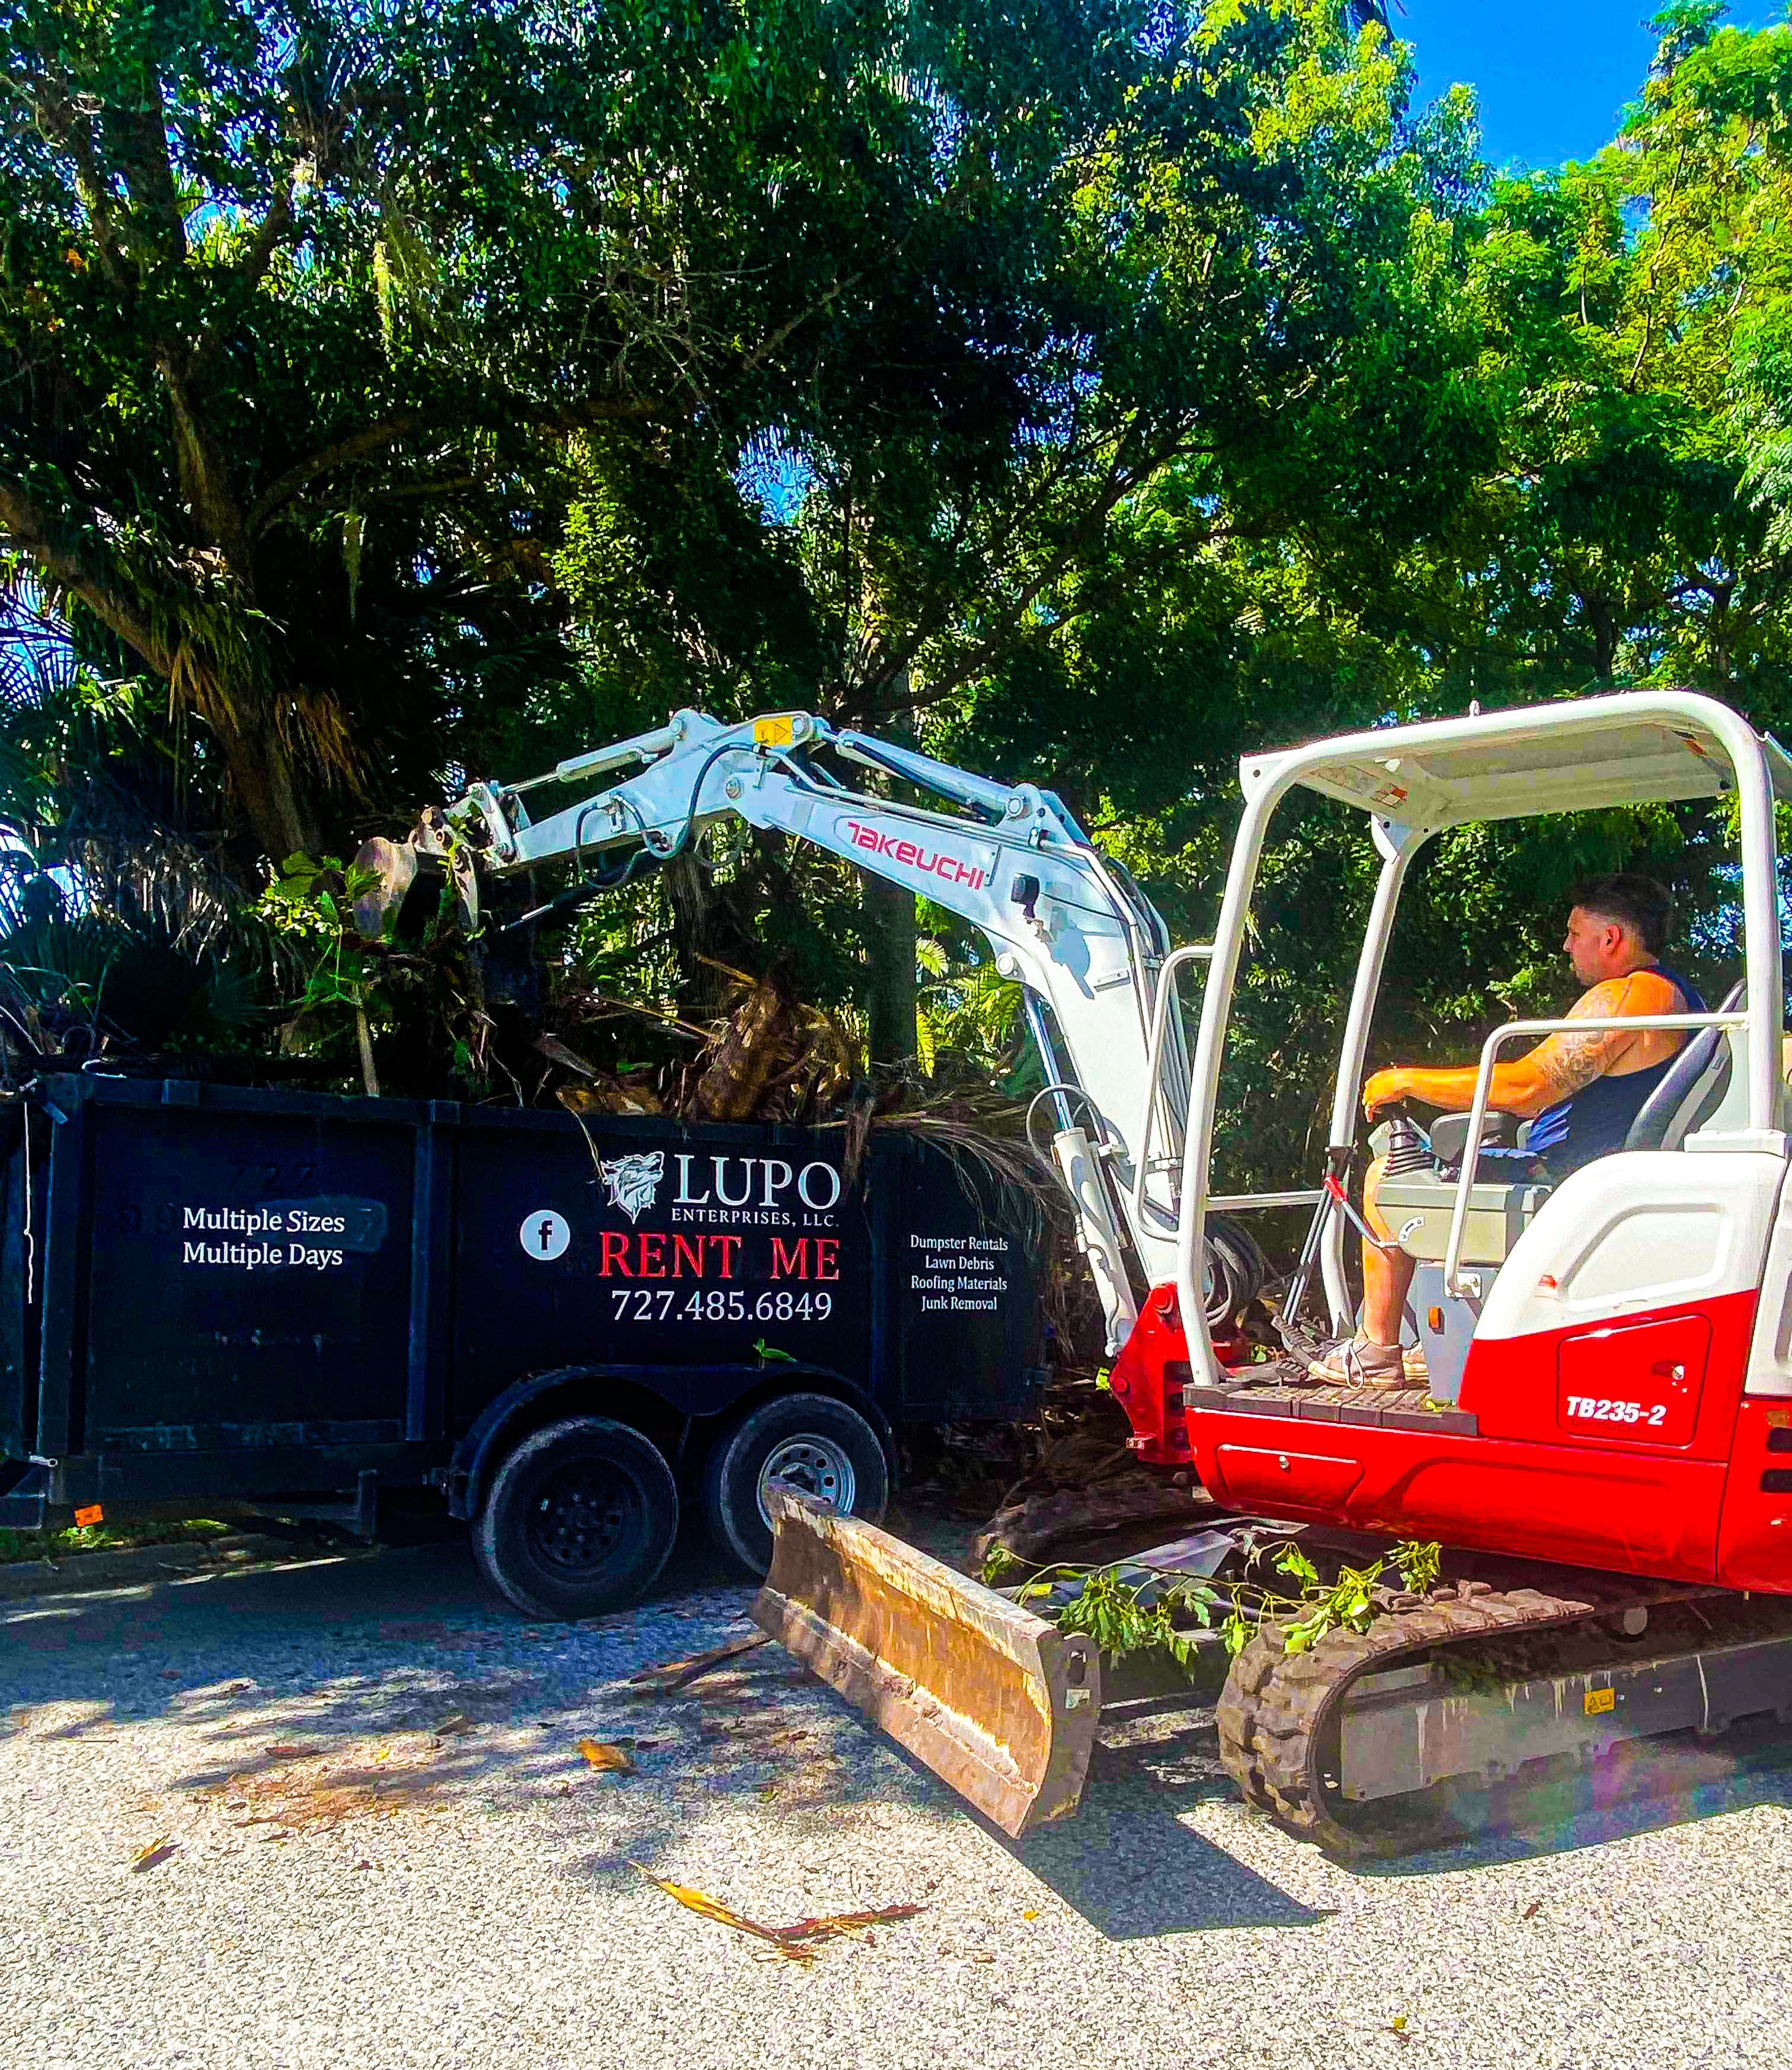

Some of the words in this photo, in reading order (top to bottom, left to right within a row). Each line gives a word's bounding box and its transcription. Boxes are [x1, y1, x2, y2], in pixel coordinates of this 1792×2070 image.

[847, 822, 984, 890] TAKEUCHI
[673, 1154, 840, 1210] LUPO
[183, 1207, 282, 1236] Multiple
[286, 1210, 345, 1233] Sizes
[671, 1208, 796, 1227] ENTERPRISES,
[803, 1214, 839, 1227] LLC.
[183, 1242, 283, 1270] Multiple
[289, 1243, 343, 1271] Days
[599, 1231, 742, 1279] RENT
[770, 1237, 840, 1281] ME
[911, 1234, 967, 1252] Dumpster
[969, 1236, 1008, 1251] Rentals
[925, 1255, 956, 1269] Lawn
[959, 1256, 994, 1271] Debris
[911, 1275, 955, 1292] Roofing
[957, 1276, 1007, 1291] Materials
[612, 1290, 831, 1320] 727.485.6849
[921, 1295, 949, 1312] Junk
[951, 1296, 997, 1310] Removal
[1567, 1396, 1667, 1426] TB235-2
